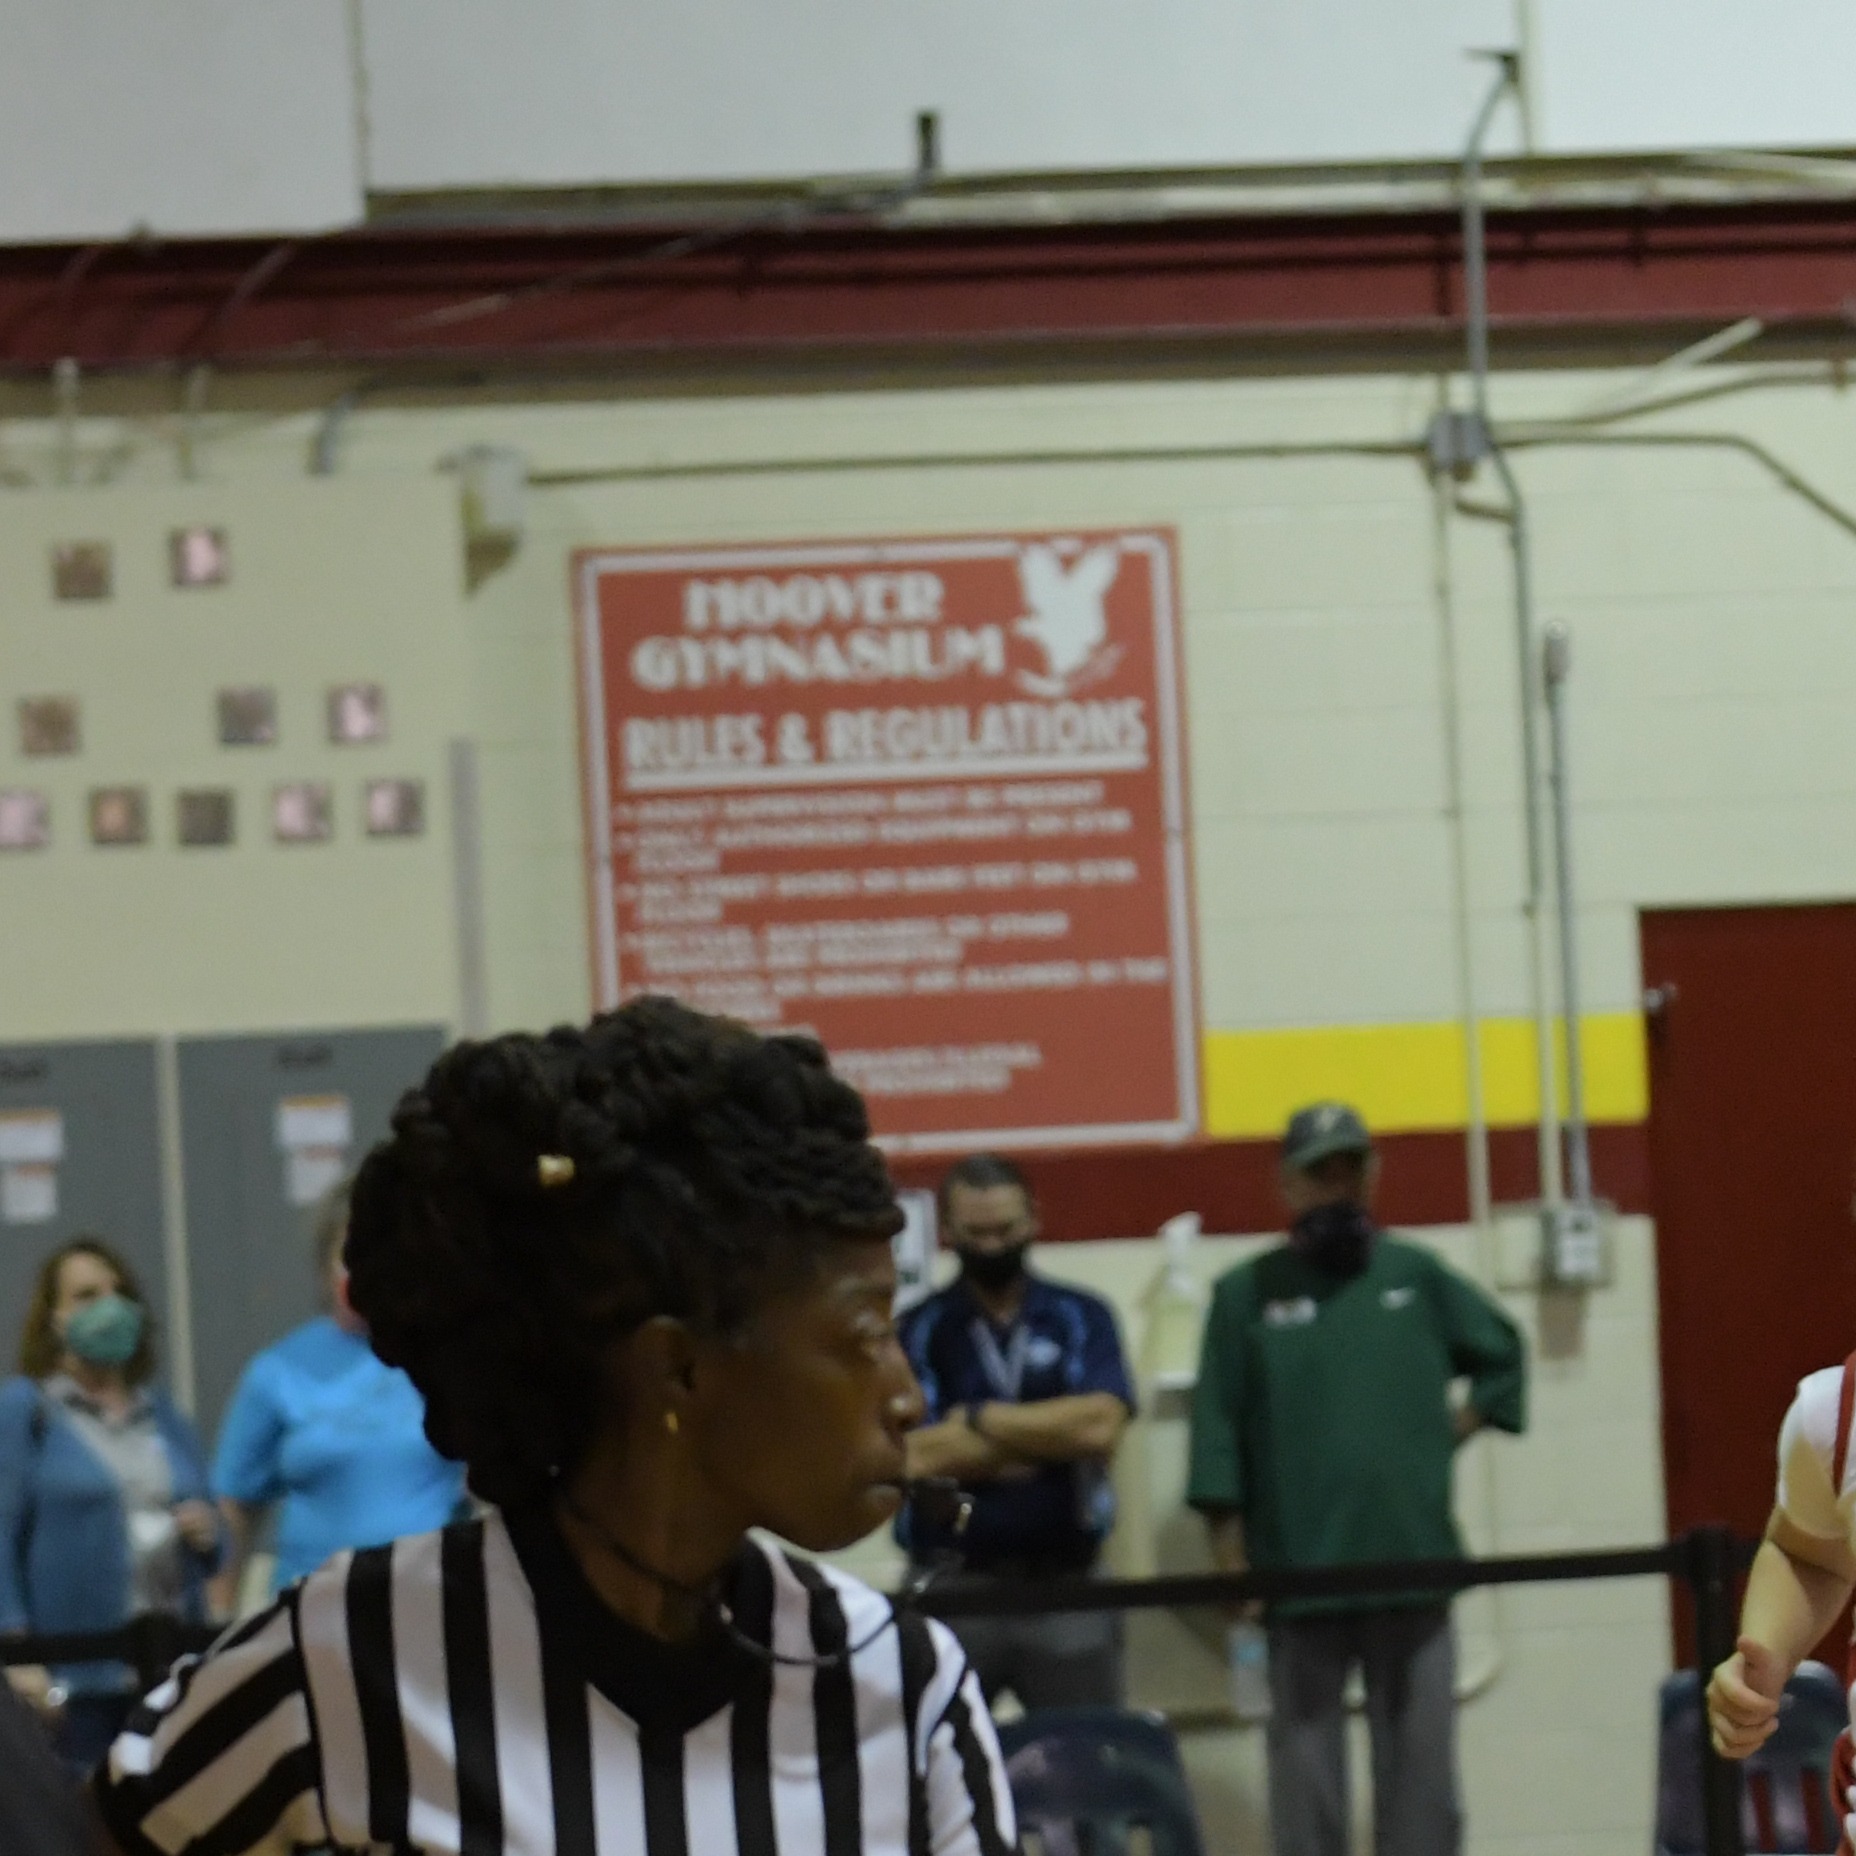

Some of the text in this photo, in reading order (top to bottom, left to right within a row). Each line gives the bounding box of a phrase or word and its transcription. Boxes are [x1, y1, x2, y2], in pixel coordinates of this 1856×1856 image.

[682, 568, 946, 632] HOOVER
[631, 623, 1006, 692] GYMNASIUM
[622, 699, 1148, 770] RULES & REGULATIONS
